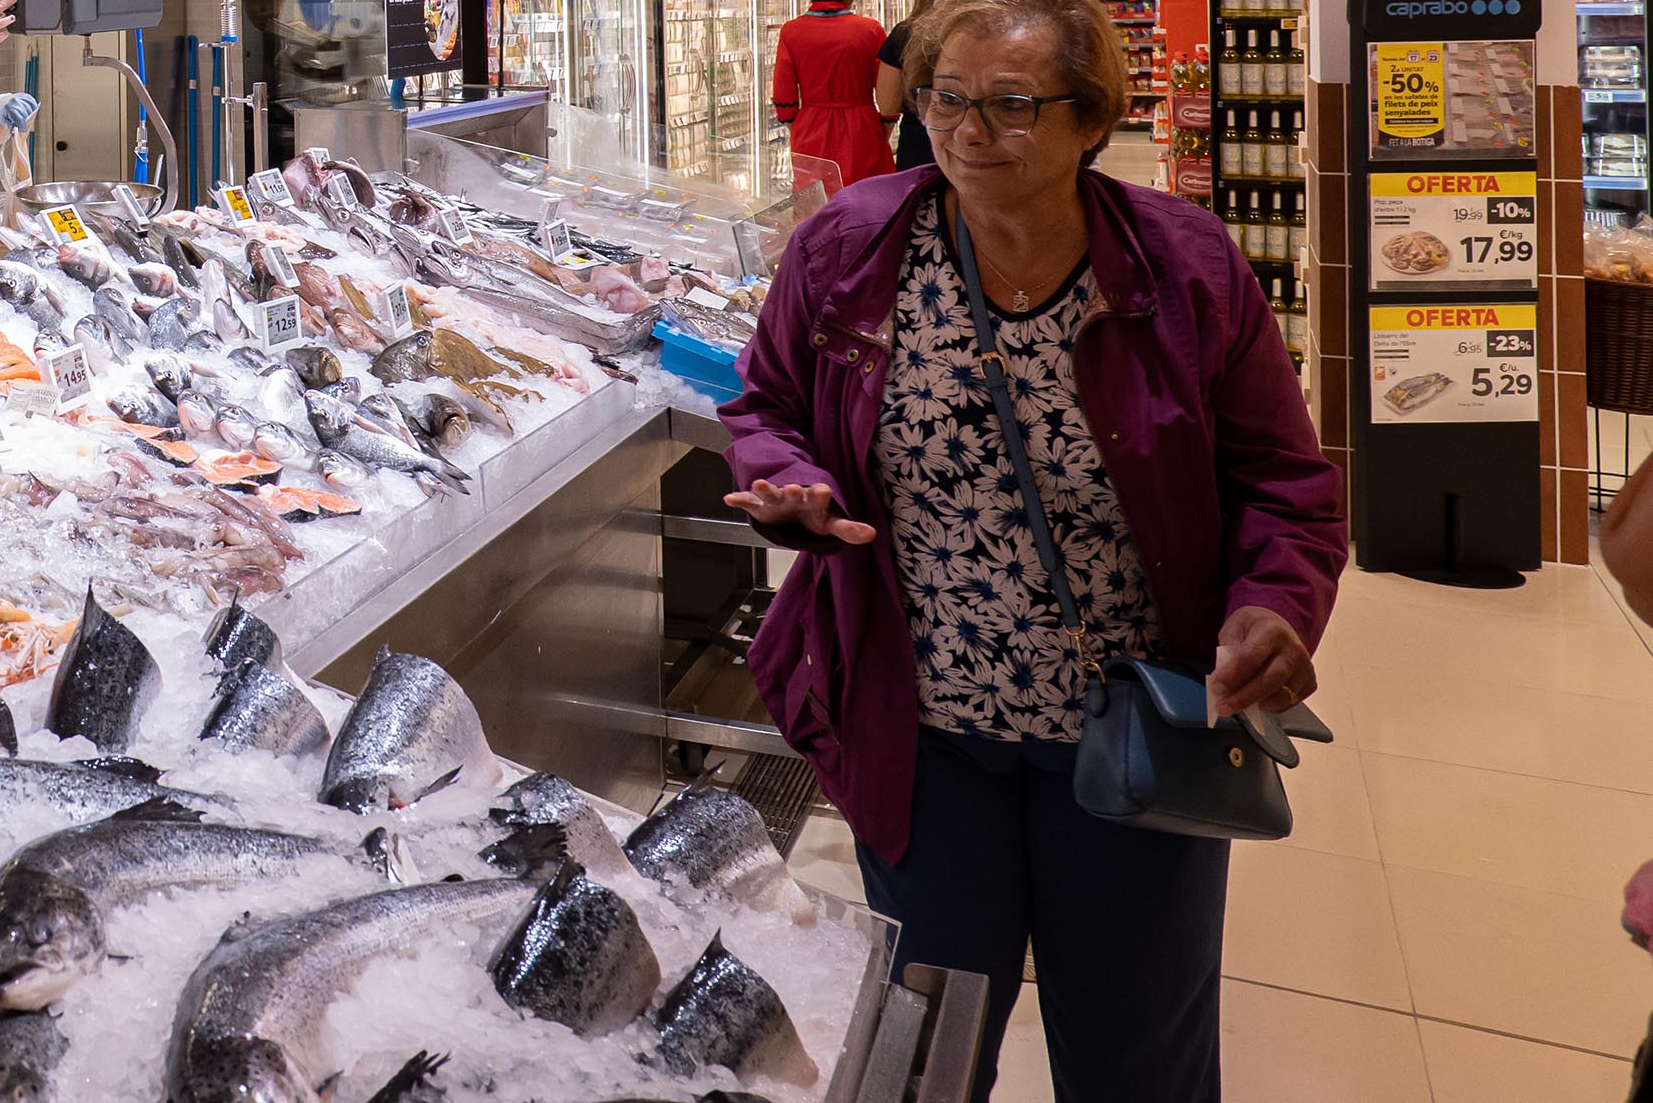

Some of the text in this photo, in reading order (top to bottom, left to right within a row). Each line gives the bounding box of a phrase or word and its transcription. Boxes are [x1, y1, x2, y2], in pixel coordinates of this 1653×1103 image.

[1383, 73, 1439, 94] -50%
[1384, 109, 1431, 117] senyalades
[1420, 100, 1439, 109] peix
[1389, 138, 1399, 146] FET
[1412, 137, 1435, 146] BOTIGA
[1406, 175, 1500, 193] OFERTA
[1490, 201, 1531, 218] -10%
[1500, 230, 1523, 239] €/kg
[1460, 236, 1533, 264] 17,99
[1406, 308, 1500, 326] OFERTA
[1489, 335, 1531, 351] -23%
[1471, 368, 1533, 398] 5,29
